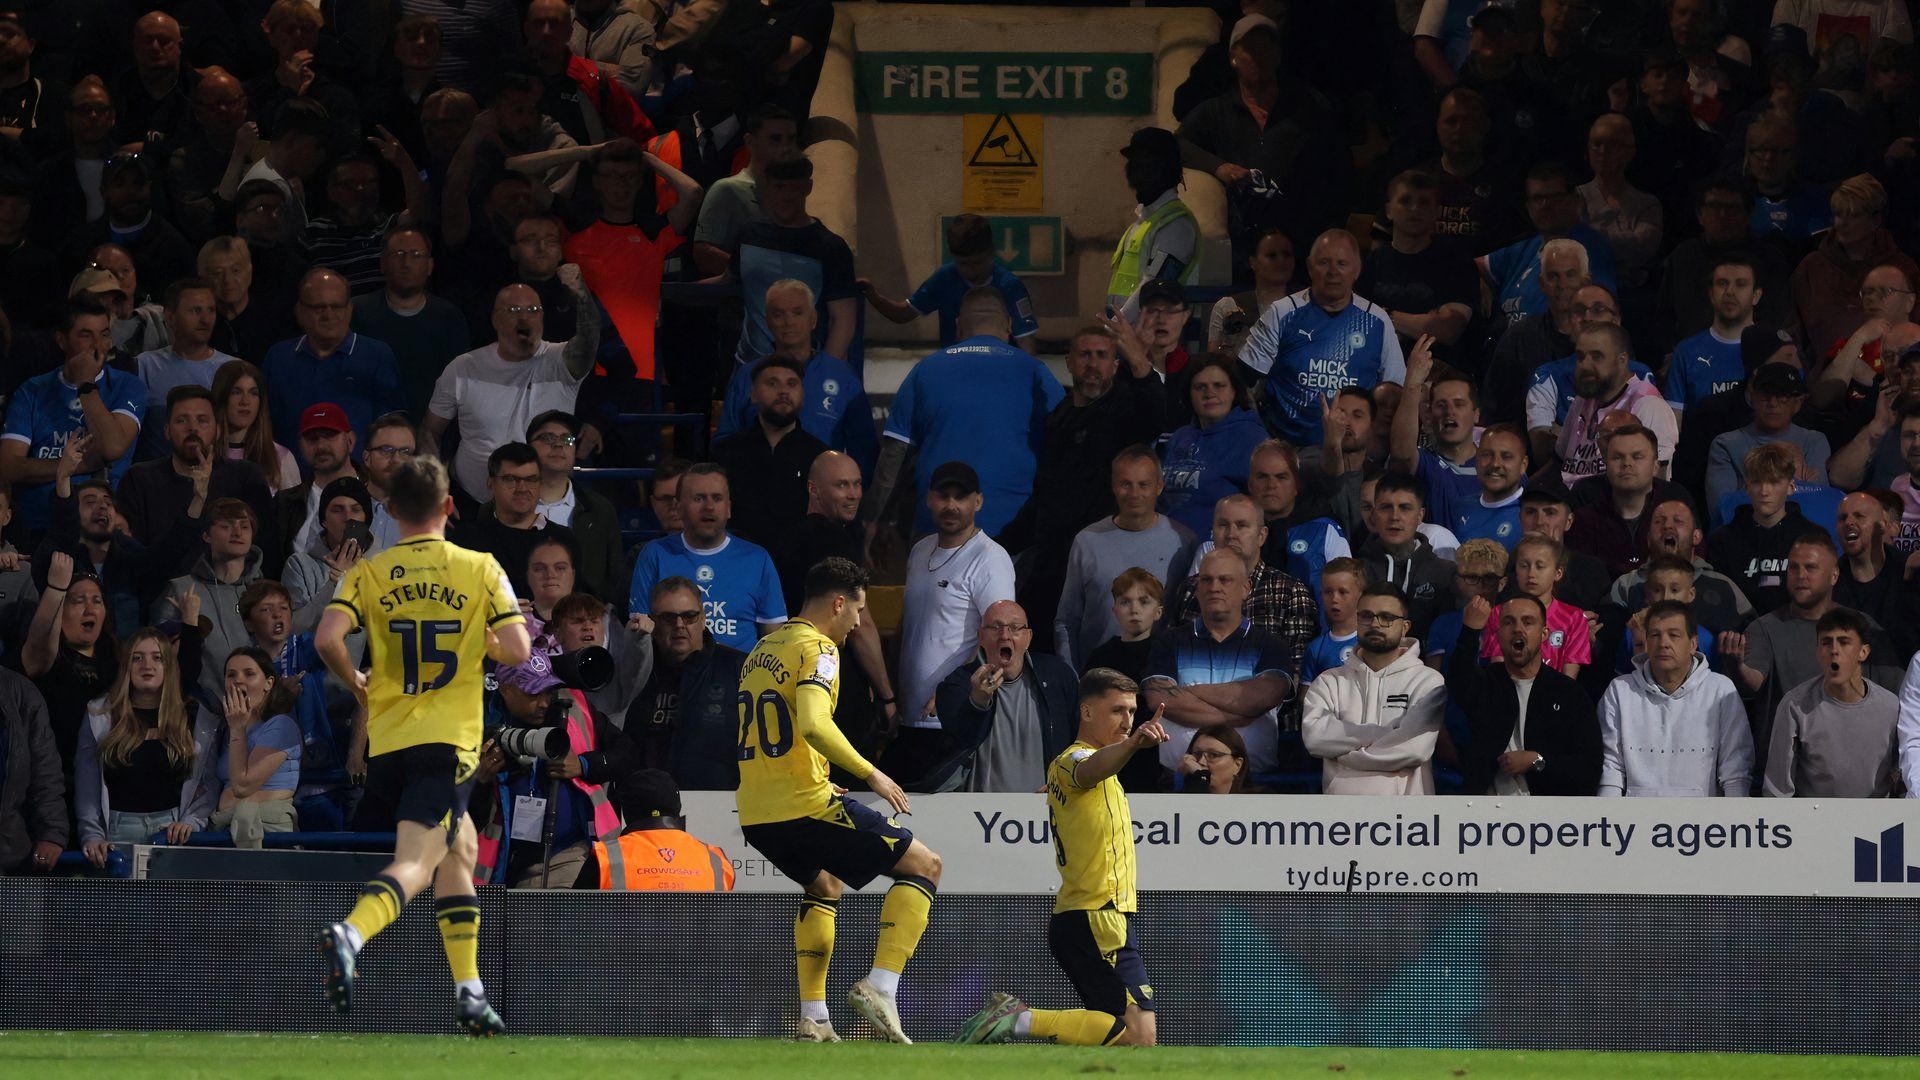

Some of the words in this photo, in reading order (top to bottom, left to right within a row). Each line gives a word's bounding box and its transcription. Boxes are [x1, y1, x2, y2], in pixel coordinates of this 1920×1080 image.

[883, 64, 981, 99] FIRE
[996, 64, 1093, 99] EXIT
[1104, 65, 1129, 100] 8
[1298, 372, 1359, 390] GEORGE
[1308, 358, 1348, 376] MICK
[379, 582, 468, 613] STEVENS
[702, 601, 727, 618] CK
[704, 618, 737, 636] RGE
[388, 619, 462, 696] 15
[740, 652, 791, 685] ODRIGUES
[737, 688, 794, 761] 20
[973, 811, 1049, 845] You
[1198, 814, 1440, 847] commercial
[1458, 816, 1636, 856] property
[1651, 817, 1793, 857] agents
[1286, 866, 1479, 891] tyduspre.com
